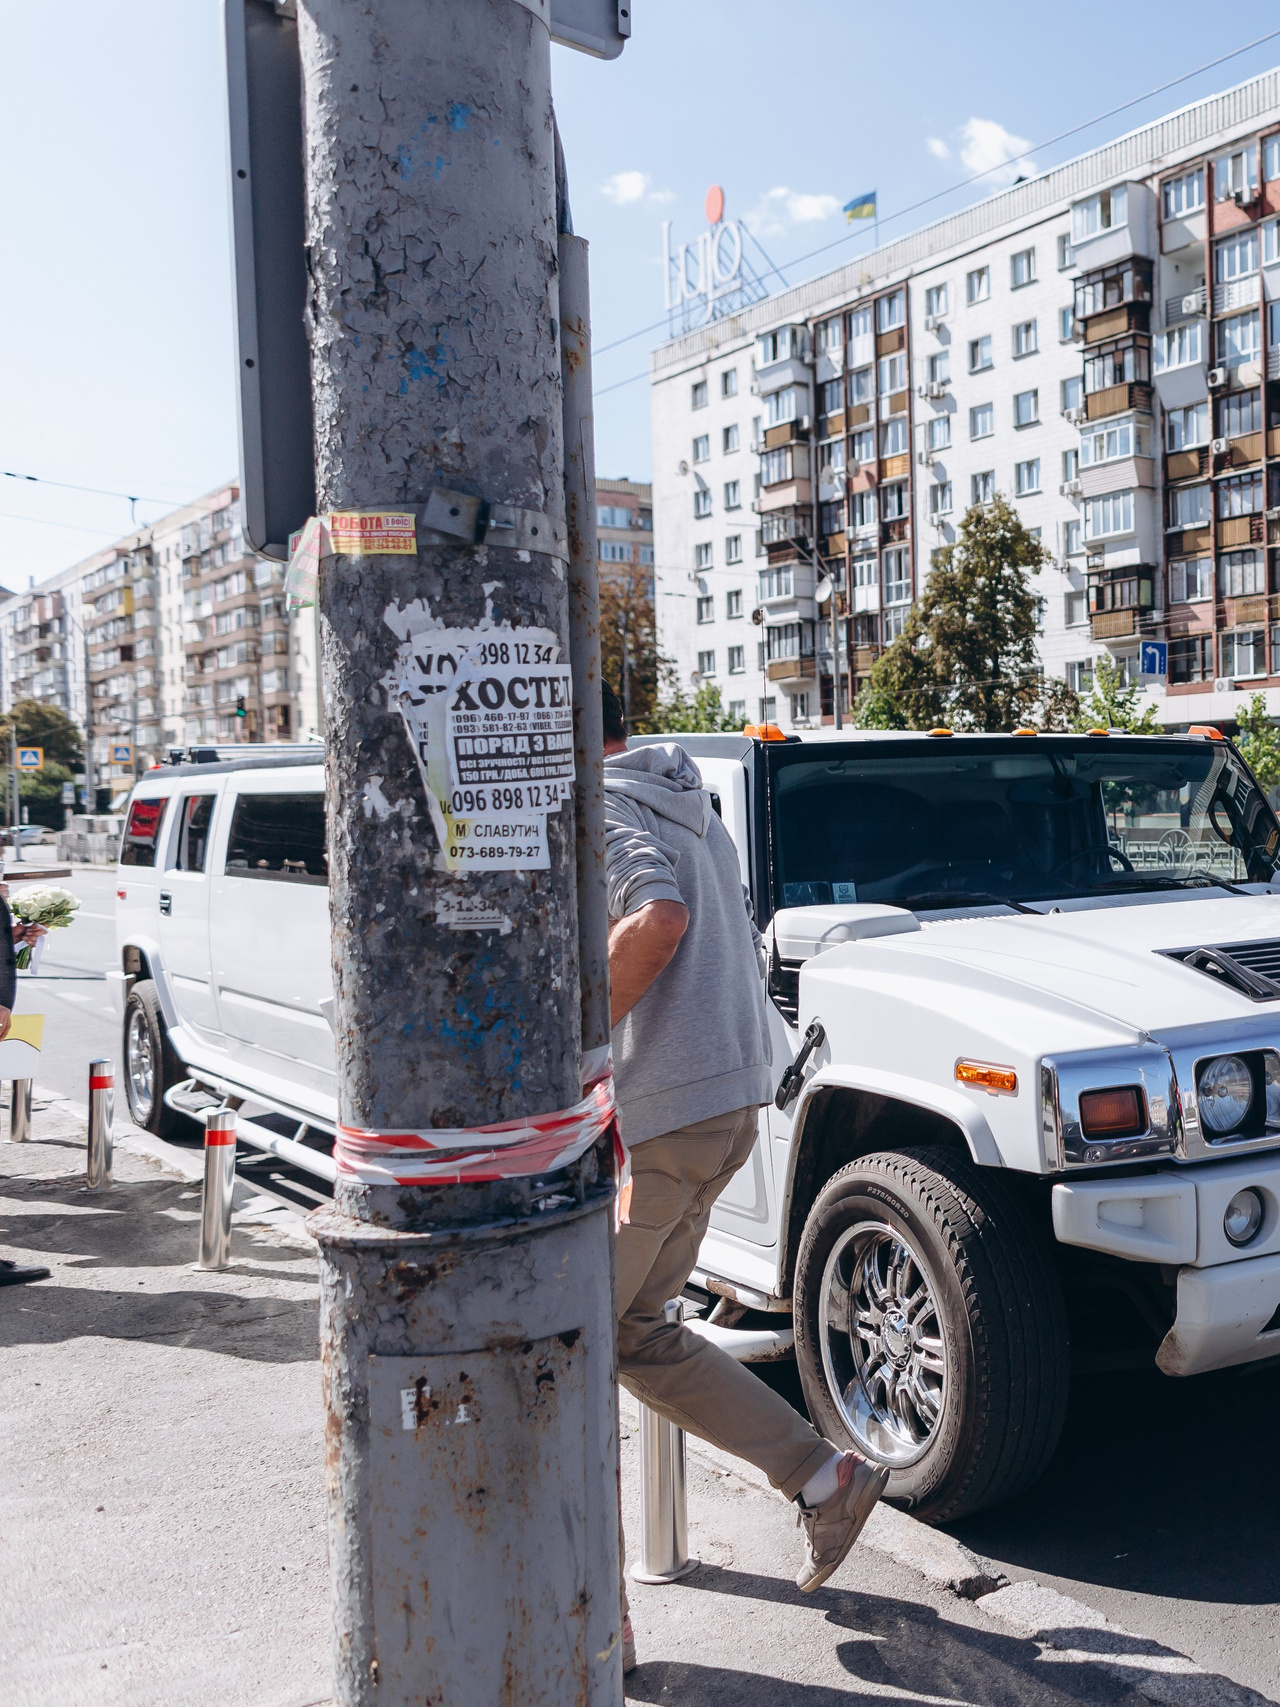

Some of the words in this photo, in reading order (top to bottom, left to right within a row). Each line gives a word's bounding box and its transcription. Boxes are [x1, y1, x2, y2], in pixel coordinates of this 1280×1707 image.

[331, 516, 383, 529] РОБОТА
[514, 643, 531, 665] 12
[534, 644, 554, 665] 34
[452, 714, 481, 724] (096)
[453, 724, 481, 734] (093)
[458, 735, 531, 755] ПОРЯД
[460, 760, 477, 769] ВСІ
[478, 758, 525, 768] ЗРУЧНОСТІ
[461, 771, 479, 782] 150
[530, 766, 544, 778] 600
[452, 790, 487, 812] 096
[492, 787, 523, 811] 898
[527, 786, 542, 808] 12
[544, 783, 559, 806] 34
[474, 824, 539, 838] СЛАВУТИЧ
[450, 846, 541, 858] 073-689-79-27
